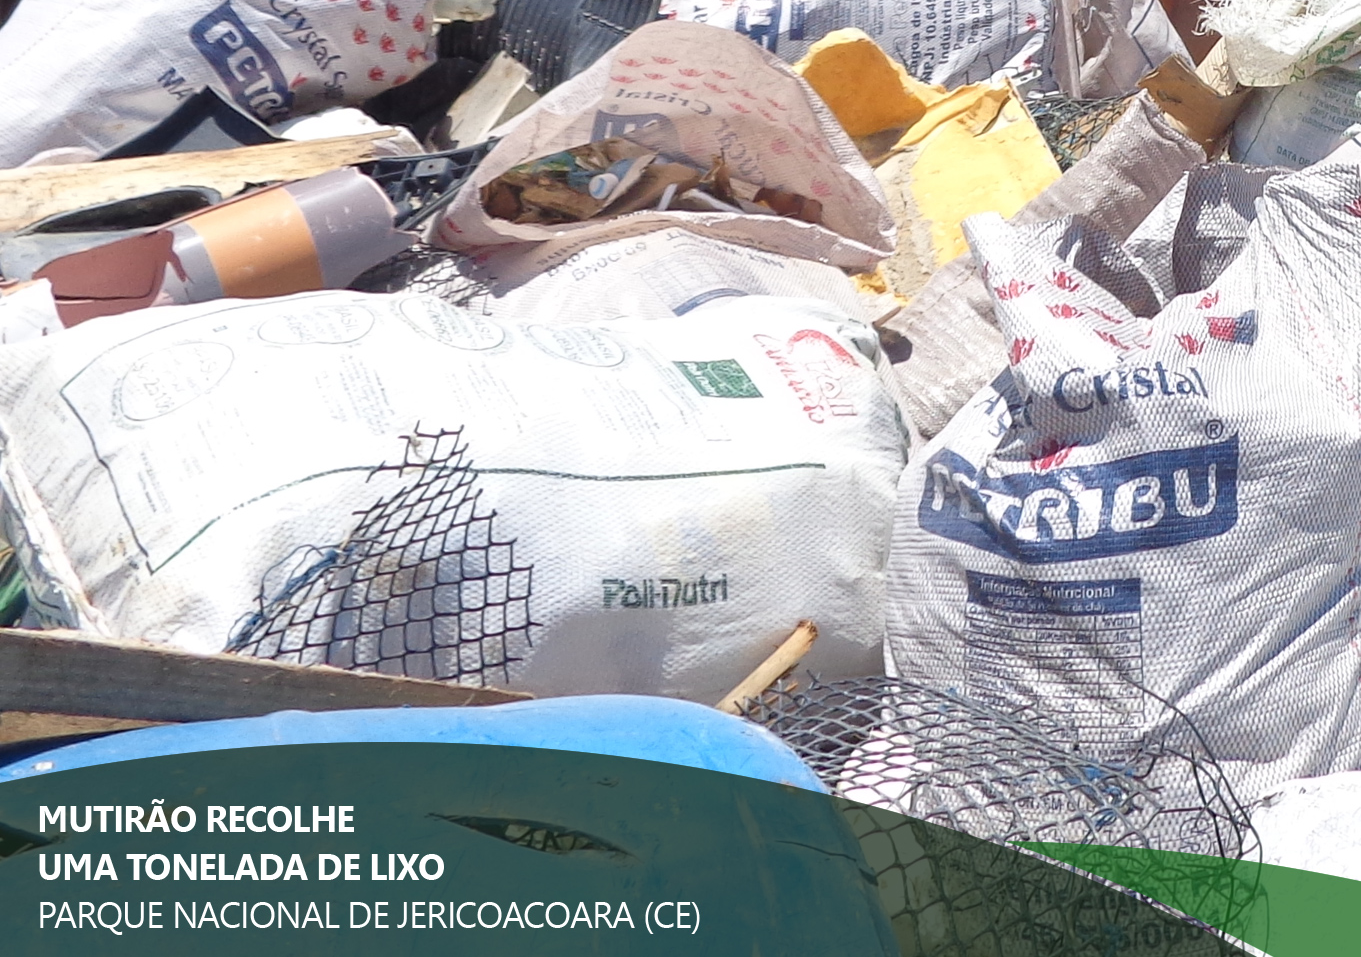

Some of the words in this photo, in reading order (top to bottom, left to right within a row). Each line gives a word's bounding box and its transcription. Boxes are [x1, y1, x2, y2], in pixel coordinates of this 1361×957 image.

[936, 0, 953, 65] Indústria
[920, 47, 937, 84] NPJ:
[1053, 351, 1209, 414] Cristal
